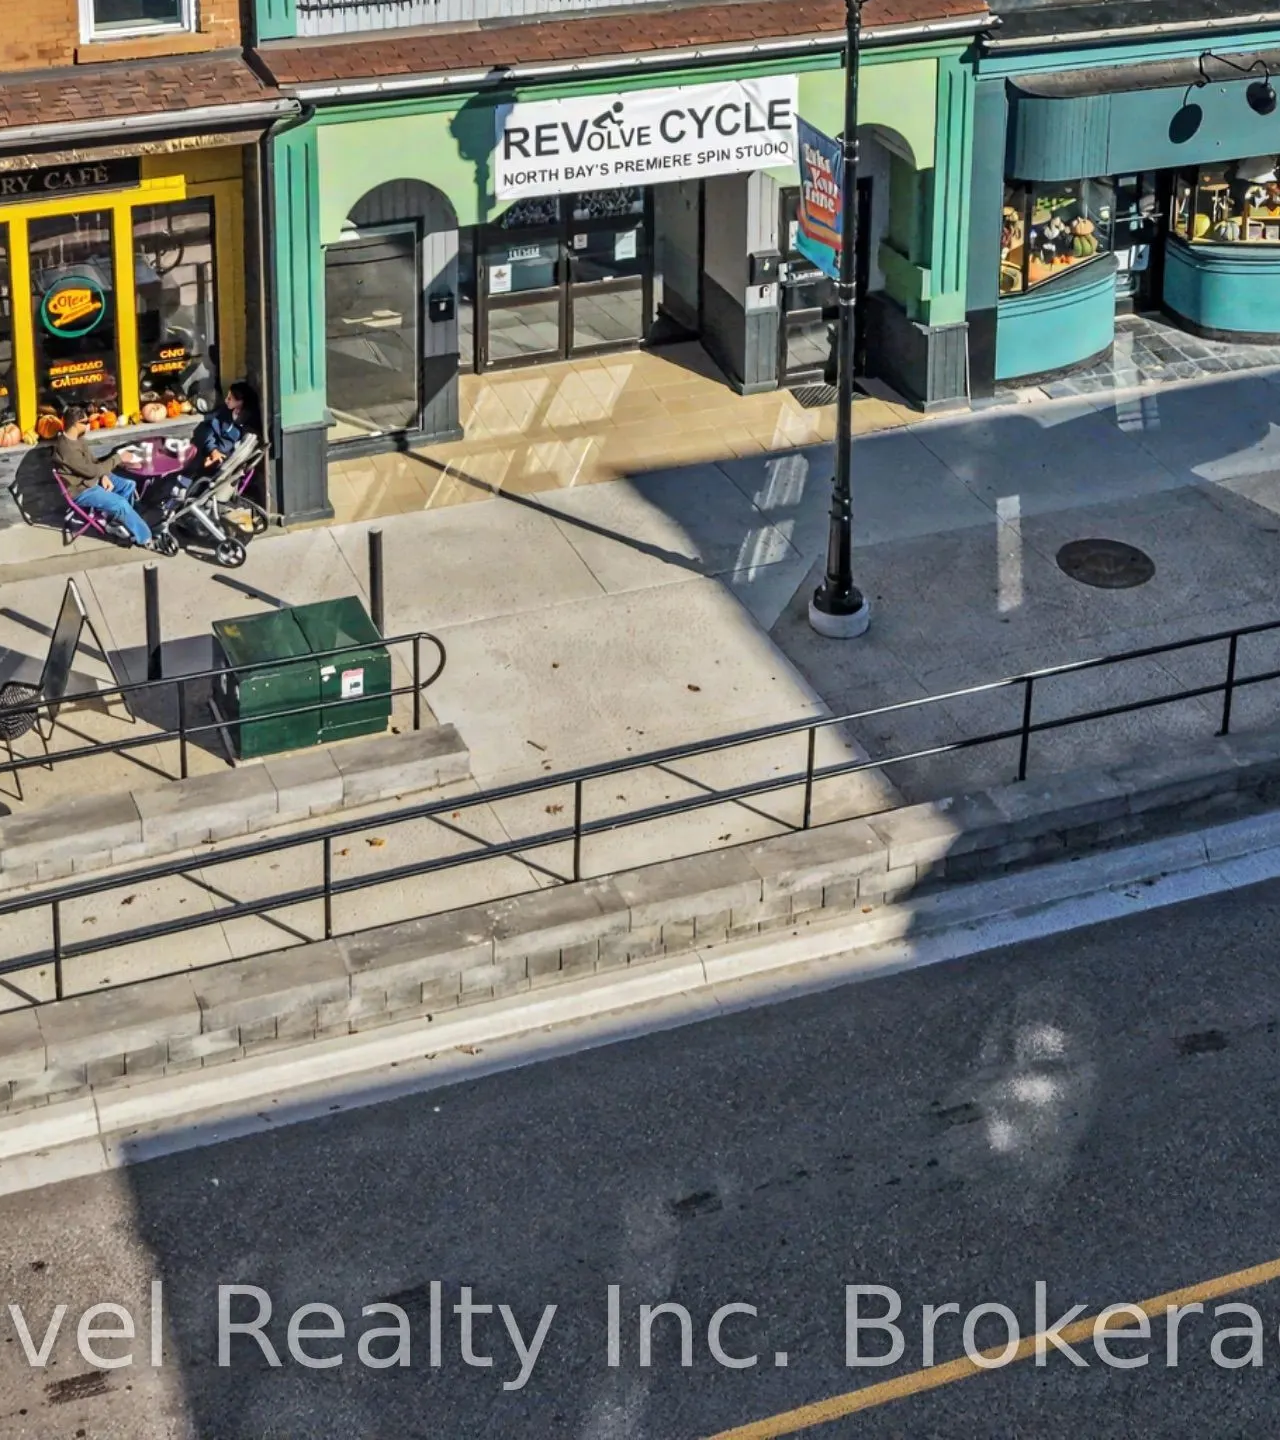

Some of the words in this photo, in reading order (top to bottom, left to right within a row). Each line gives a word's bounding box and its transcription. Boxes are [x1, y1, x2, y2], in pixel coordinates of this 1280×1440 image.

[659, 98, 792, 143] CYCLE
[503, 169, 560, 186] NORTH
[564, 163, 610, 180] BAY'S
[614, 153, 692, 174] PREMIERE
[697, 148, 731, 165] SPIN
[735, 141, 789, 159] STUDIO
